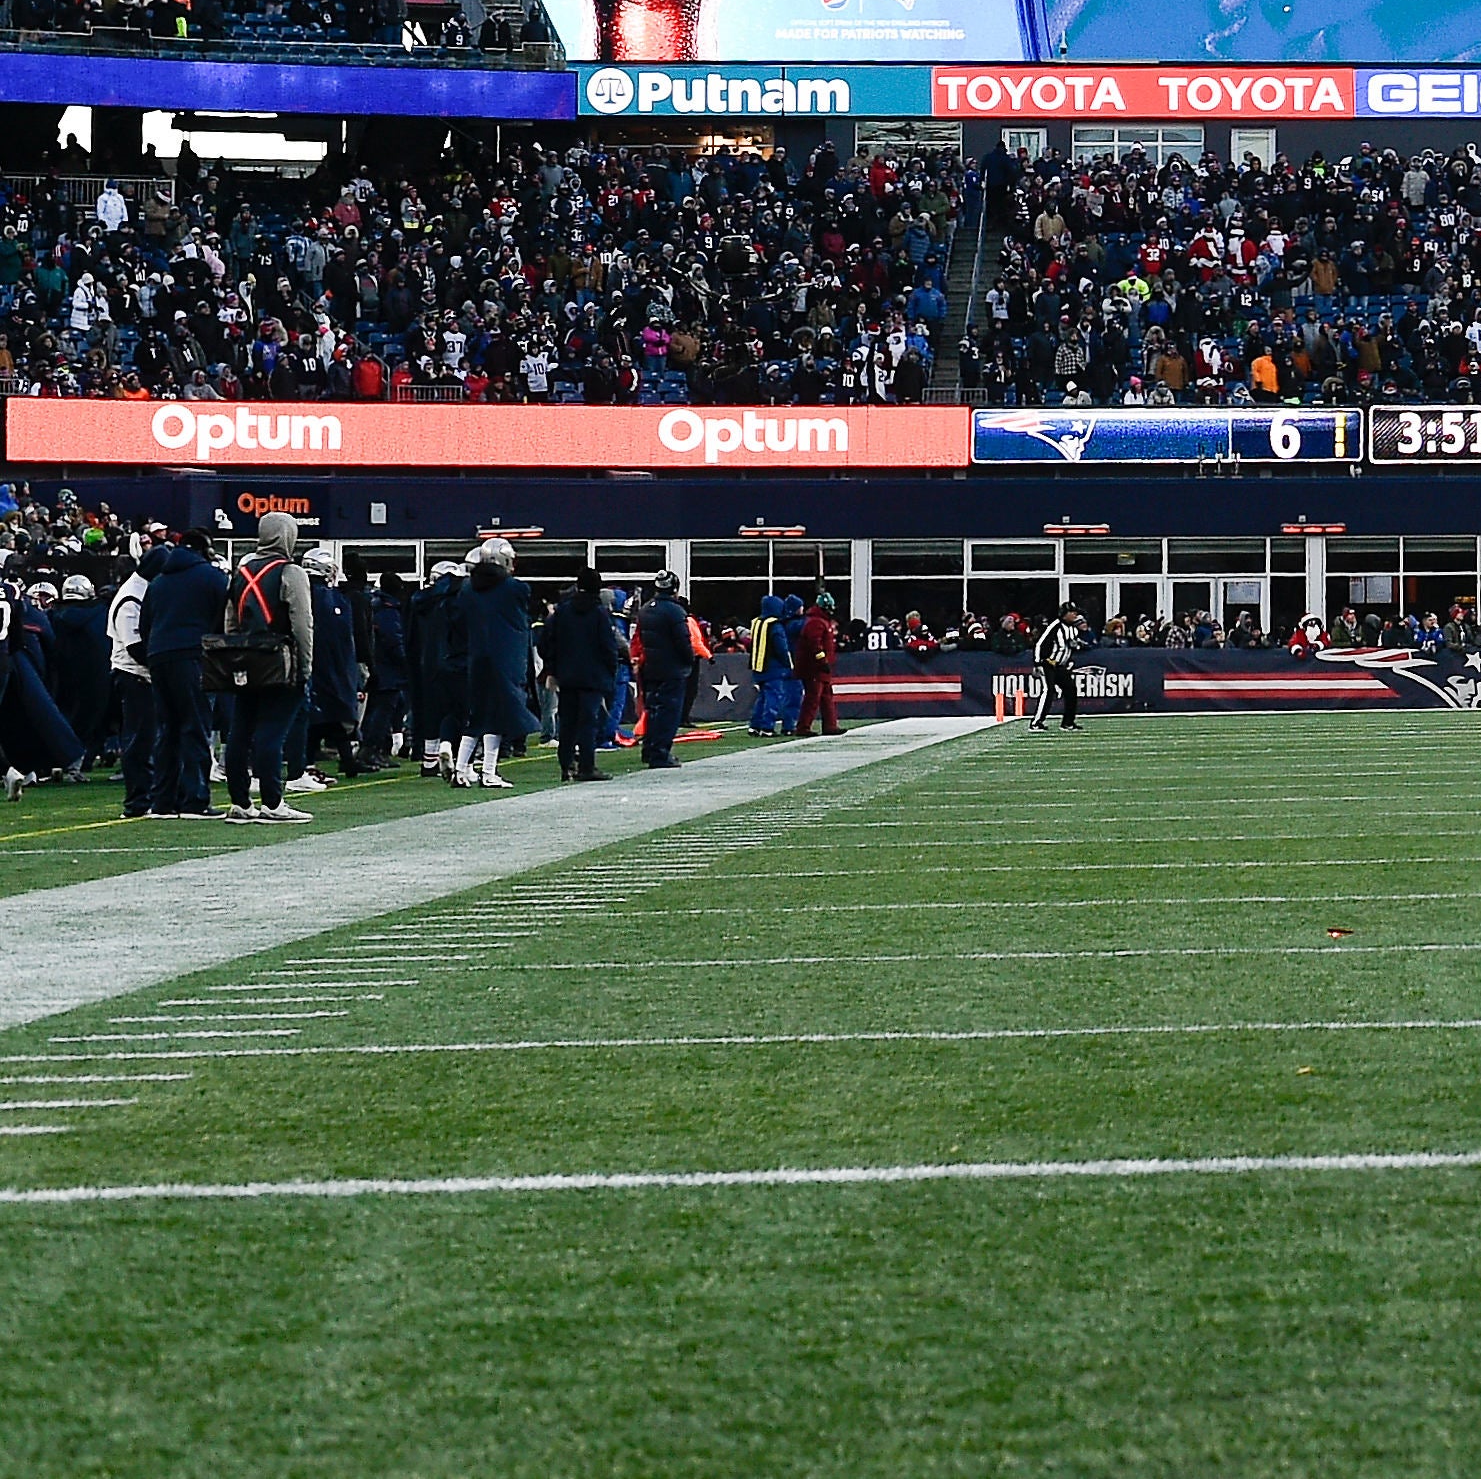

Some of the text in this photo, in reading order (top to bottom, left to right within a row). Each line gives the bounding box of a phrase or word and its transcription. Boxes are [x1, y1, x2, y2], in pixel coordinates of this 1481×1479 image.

[775, 28, 966, 40] MADE FOR PATRIOTS WATCHING
[636, 72, 850, 114] Putnam
[937, 76, 1345, 111] TOYOTA TOYOTA
[152, 404, 342, 460] Optum
[658, 409, 849, 463] Optum
[1267, 412, 1301, 454] 6
[238, 492, 309, 517] Optum
[867, 632, 889, 651] 81
[993, 673, 1134, 699] VOLUERISM
